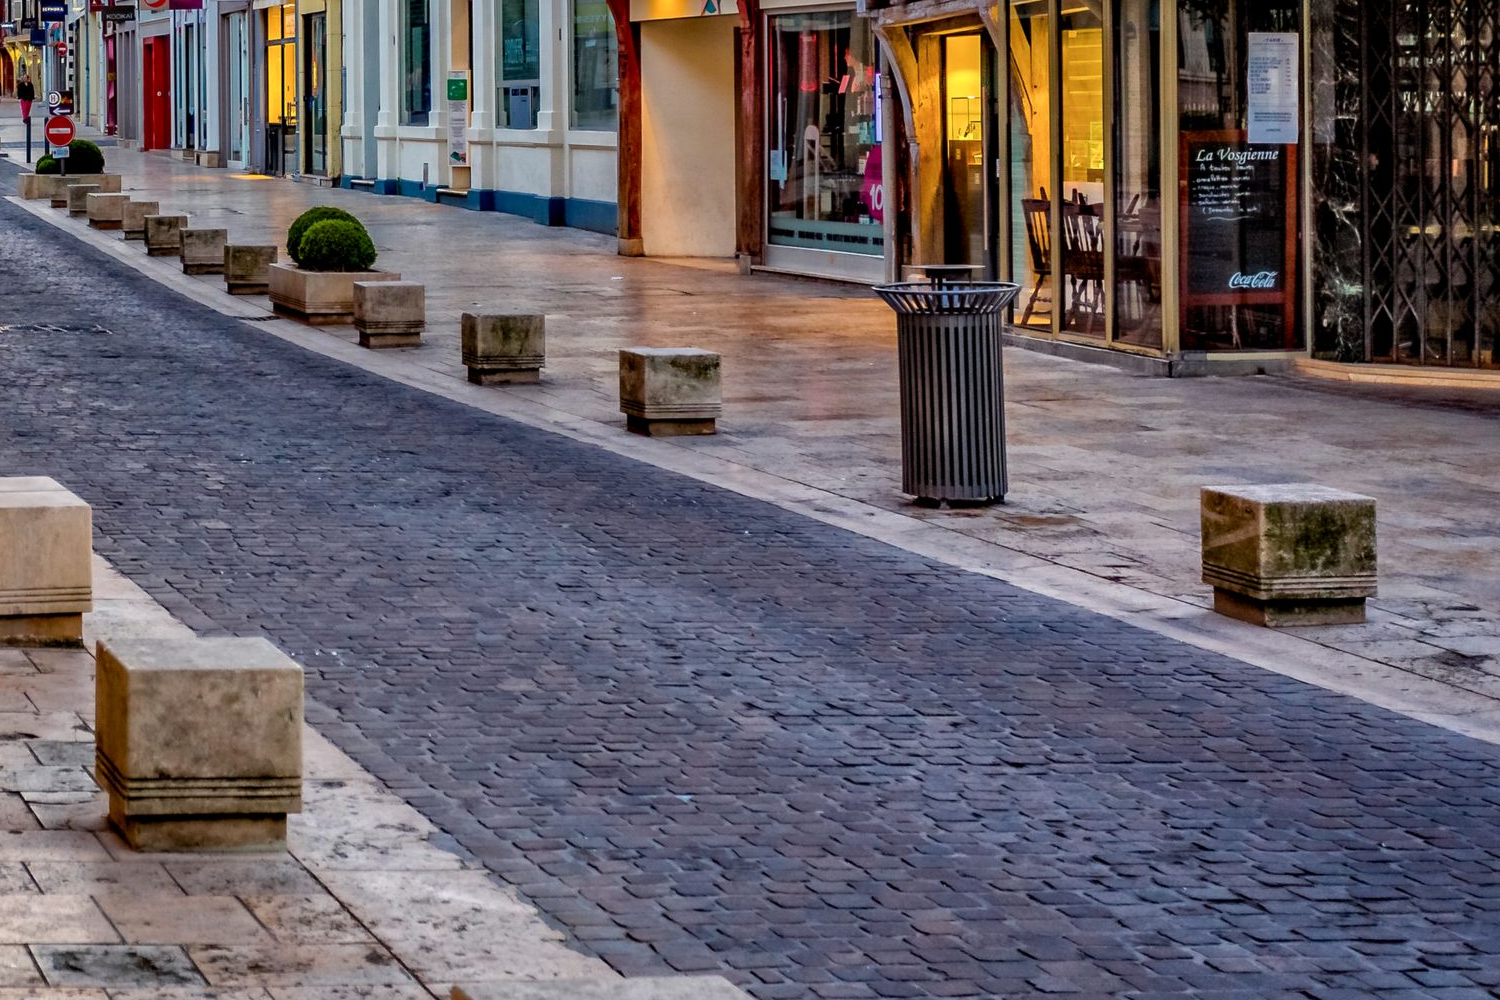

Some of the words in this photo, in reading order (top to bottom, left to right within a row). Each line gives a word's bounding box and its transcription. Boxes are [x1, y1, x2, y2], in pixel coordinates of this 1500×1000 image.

[1195, 149, 1213, 162] La
[1217, 147, 1279, 165] Vosgienne
[1228, 271, 1279, 289] Coca-Cola
